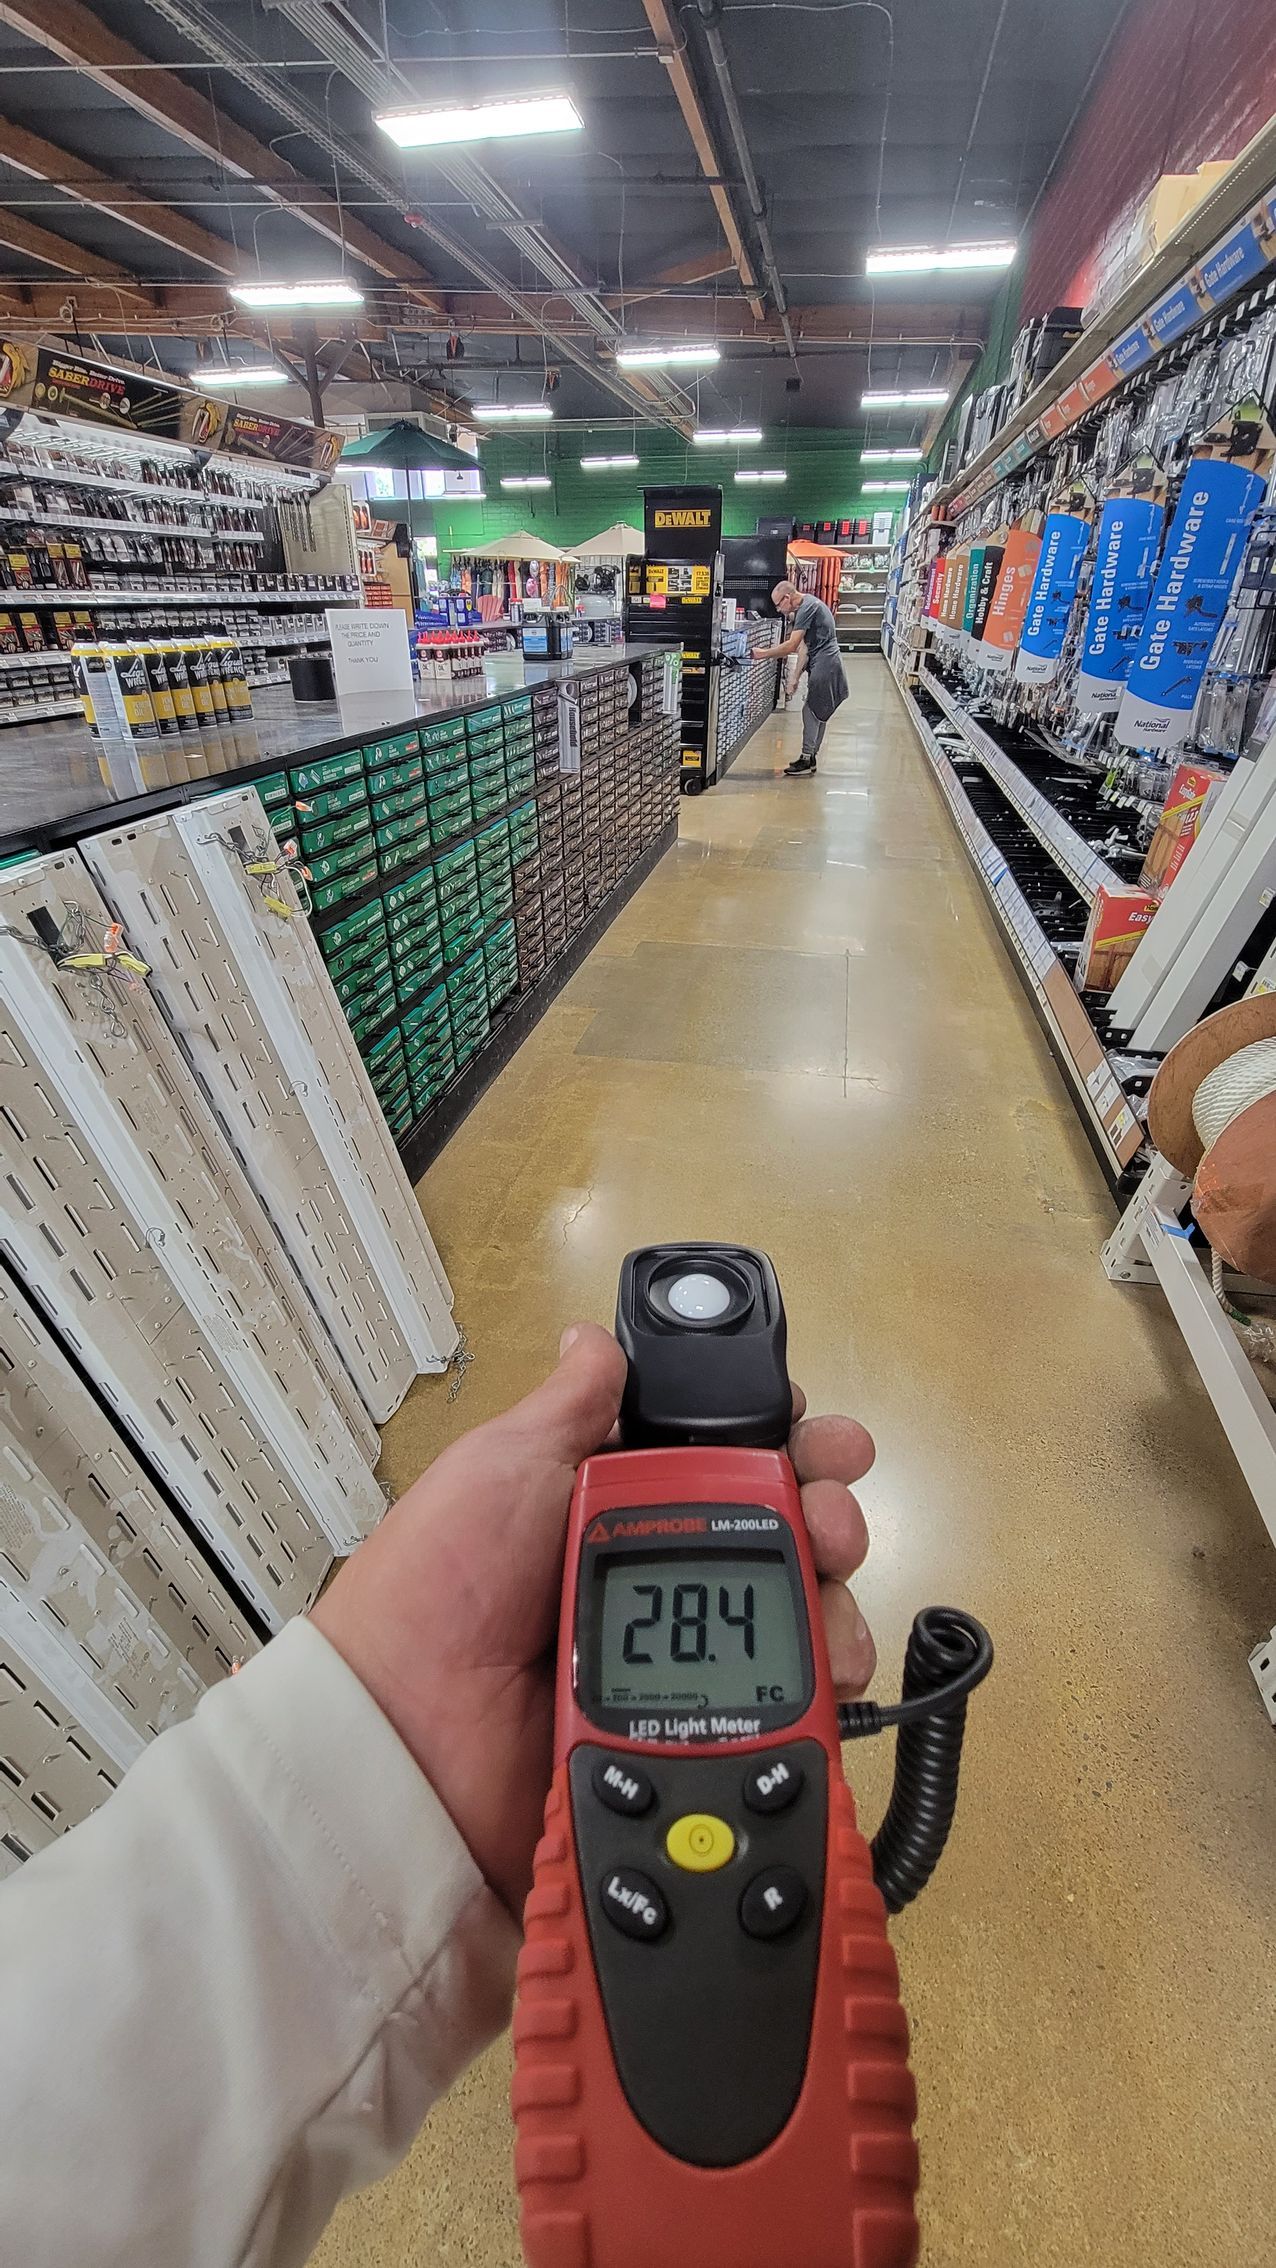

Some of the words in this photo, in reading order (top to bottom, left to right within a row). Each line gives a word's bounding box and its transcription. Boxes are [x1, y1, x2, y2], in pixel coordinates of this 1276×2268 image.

[1204, 270, 1219, 288] Gate
[1215, 247, 1245, 279] Hardware
[48, 366, 126, 396] SABERDRIVE
[1034, 531, 1061, 601] Hardware
[1095, 519, 1124, 610] Hardware
[1155, 491, 1210, 611] Hardware
[932, 572, 945, 604] Security
[944, 567, 953, 599] Hardware
[952, 564, 964, 600] Hardware
[982, 561, 994, 585] Craft
[965, 563, 980, 619] Organization
[980, 586, 989, 595] &
[992, 566, 1016, 616] Hinges
[941, 599, 949, 617] Home
[949, 601, 958, 620] Home
[975, 594, 989, 624] Hobby
[1027, 605, 1044, 636] Gate
[347, 639, 374, 647] QUANTITY
[1089, 615, 1109, 655] Gate
[1140, 619, 1171, 670] Gate
[568, 706, 579, 748] Household
[1134, 719, 1171, 729] National
[612, 1518, 708, 1537] AMPROBE
[711, 1518, 779, 1532] LM-200LED
[622, 1583, 755, 1665] 28.4
[755, 1685, 785, 1702] FC
[629, 1719, 661, 1738] LED
[665, 1717, 707, 1740] Light
[711, 1717, 761, 1735] Meter
[604, 1764, 639, 1799] M-H
[756, 1762, 790, 1795] D-H
[607, 1876, 658, 1926] Lx/Fc
[764, 1886, 785, 1910] R
